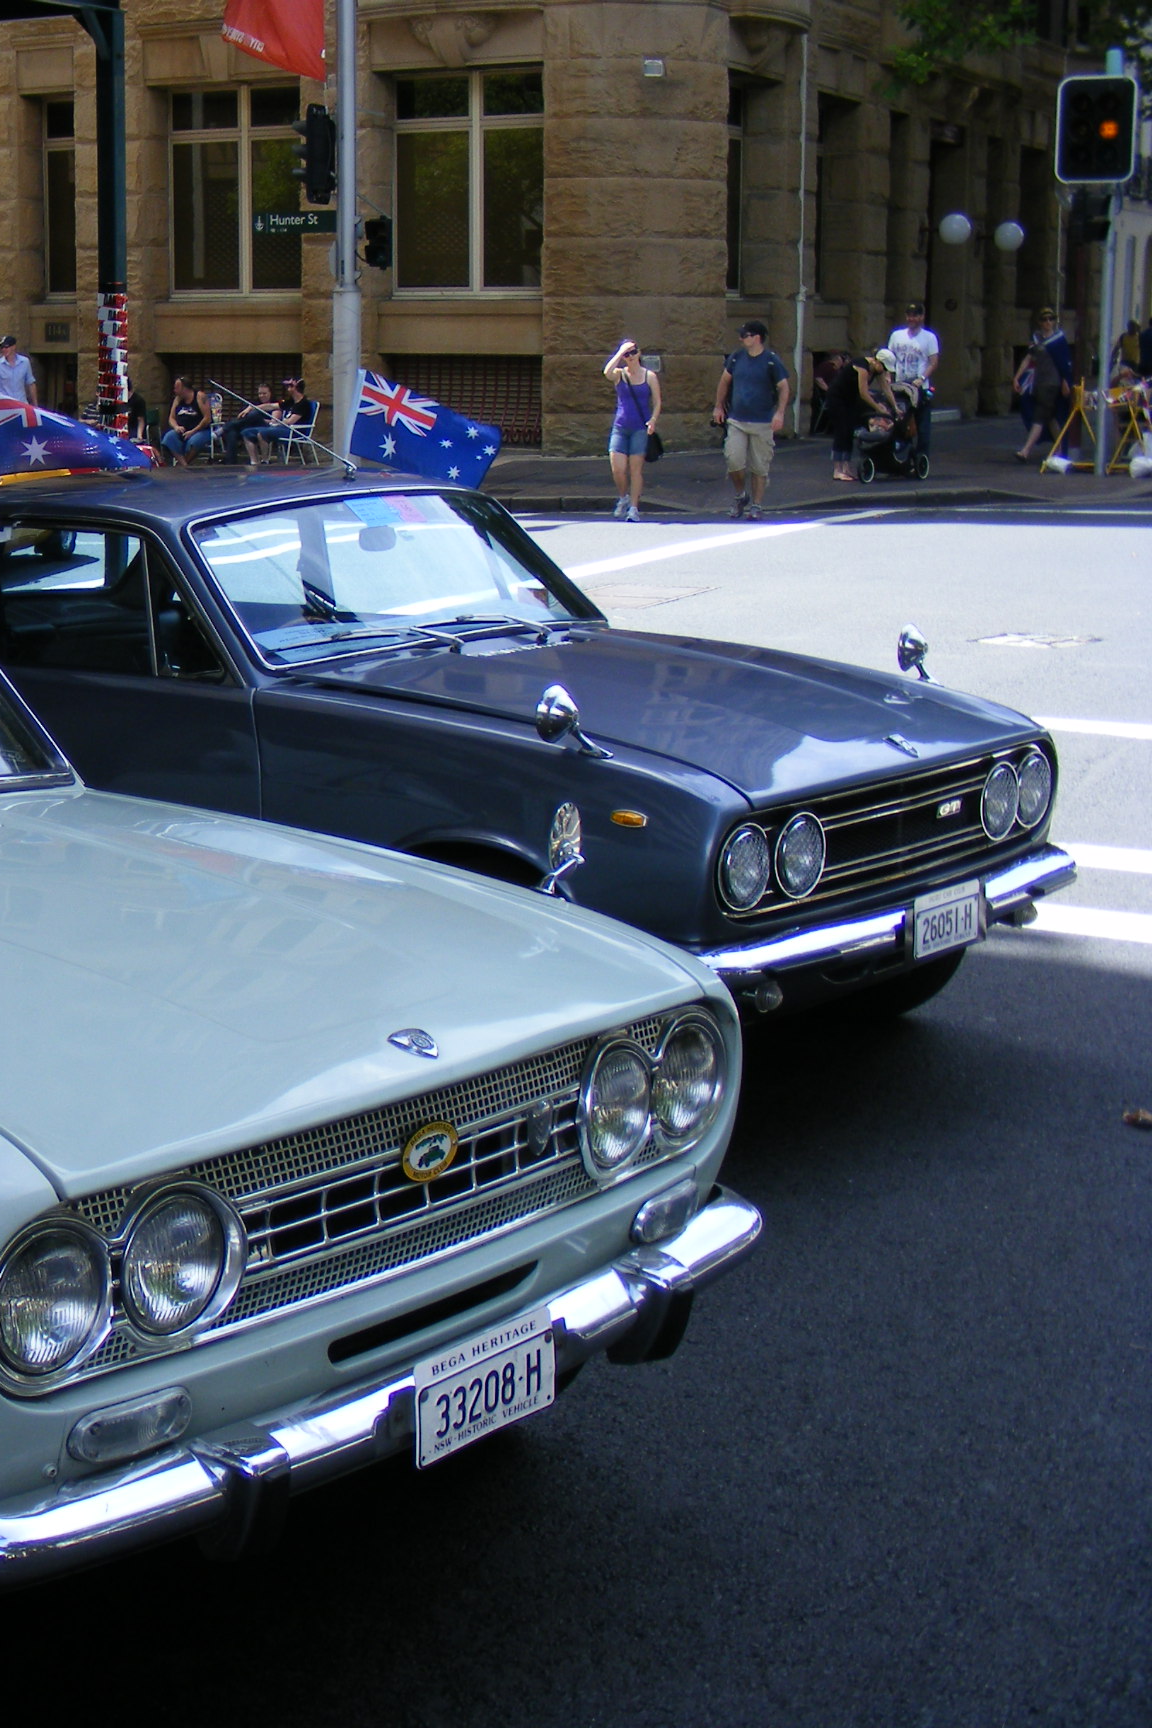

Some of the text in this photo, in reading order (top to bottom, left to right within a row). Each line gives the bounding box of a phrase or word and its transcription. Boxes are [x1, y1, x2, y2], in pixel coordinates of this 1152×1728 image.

[270, 213, 319, 226] Hunter St
[939, 800, 961, 817] GT
[432, 1319, 537, 1376] BEGA HERITAGE
[502, 1395, 539, 1419] VEHICLE
